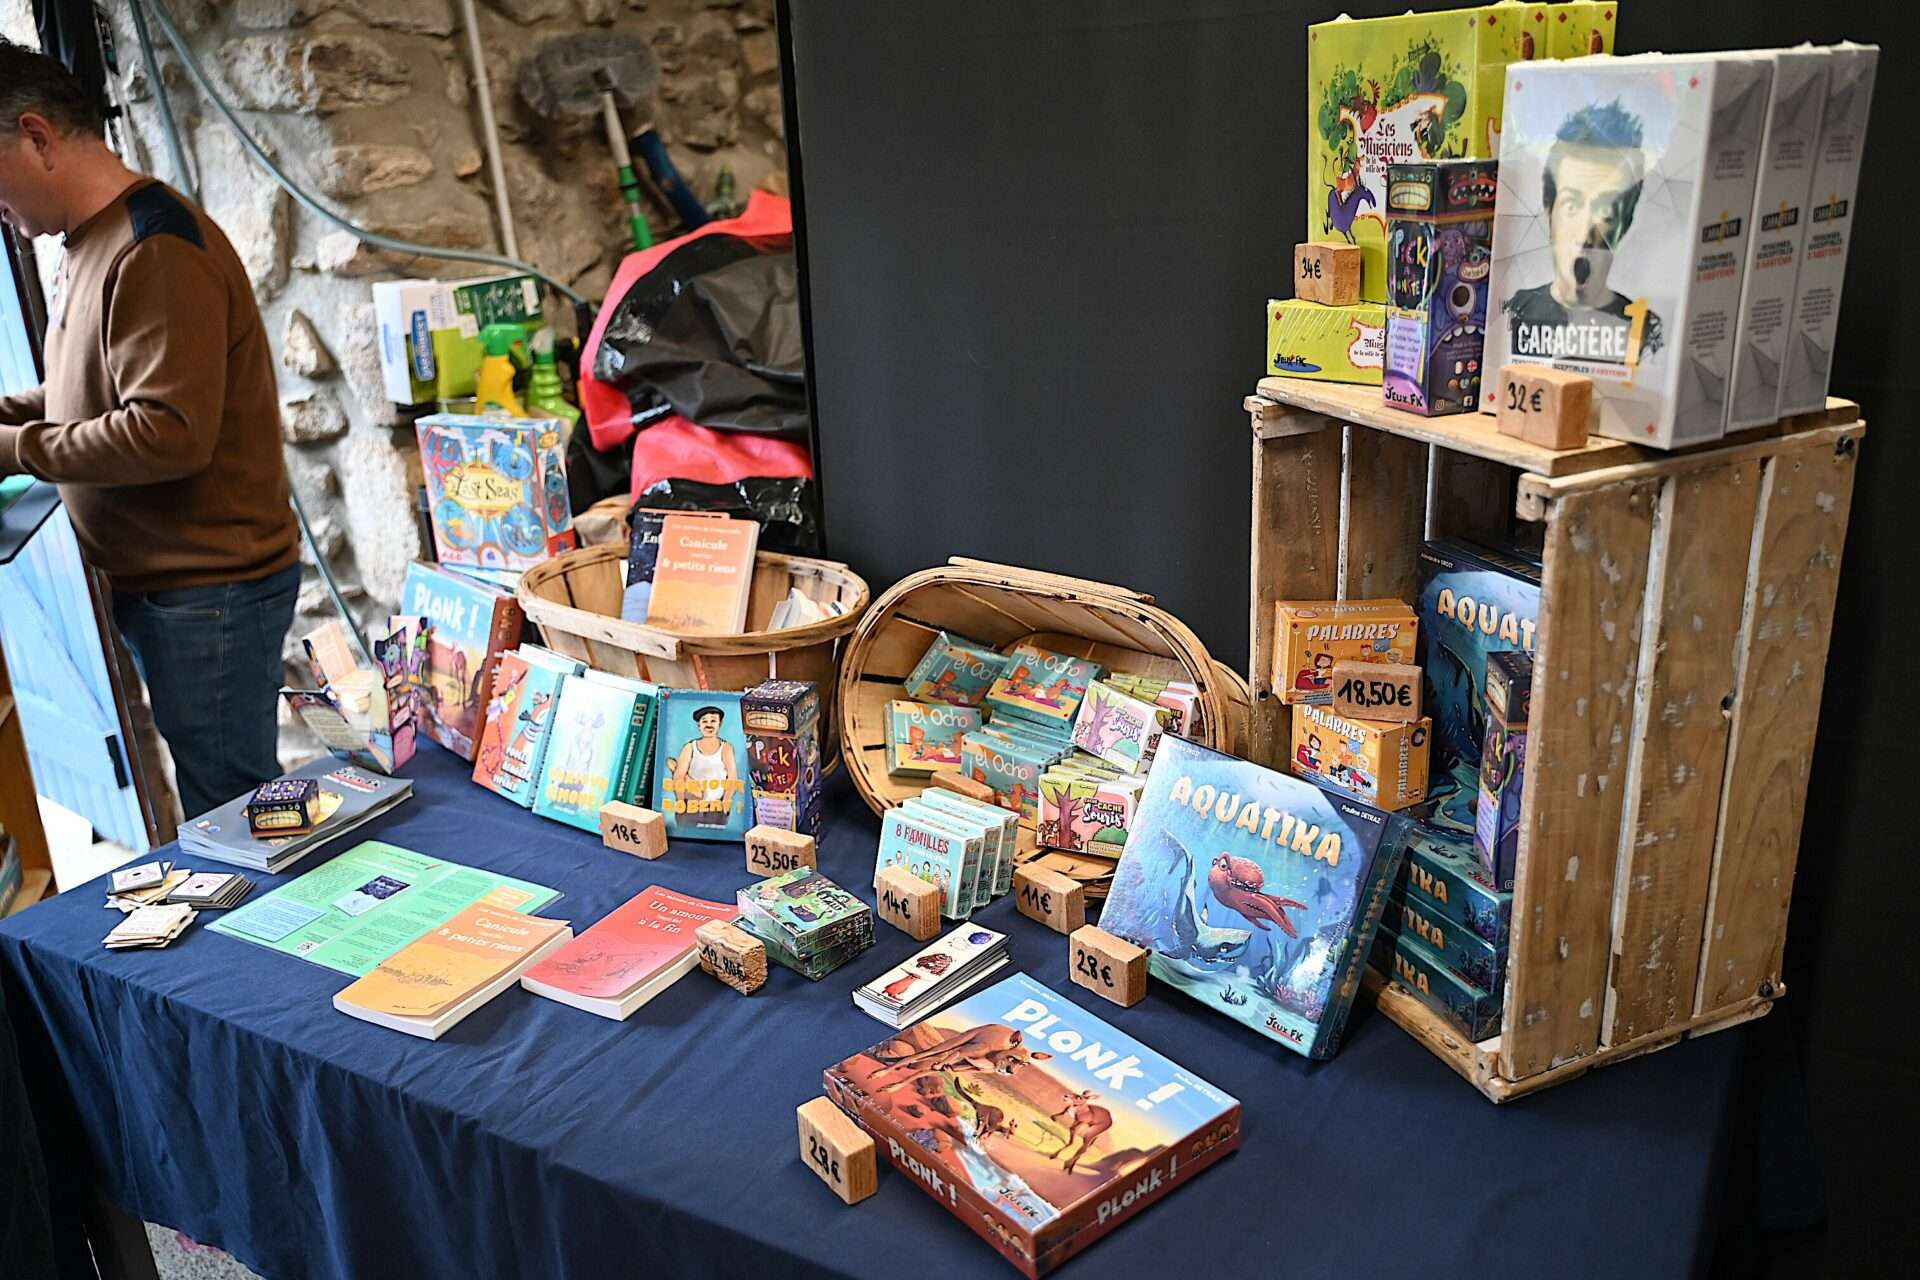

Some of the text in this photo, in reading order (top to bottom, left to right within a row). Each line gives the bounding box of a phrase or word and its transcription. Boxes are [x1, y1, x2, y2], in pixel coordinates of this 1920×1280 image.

[1376, 118, 1395, 136] Les
[1359, 136, 1413, 156] Musiciens
[1302, 257, 1321, 279] 34€
[1517, 318, 1627, 357] CARACTÈRE
[1508, 381, 1544, 413] 32€
[680, 536, 728, 550] Canicule
[414, 582, 465, 633] PLONK
[1437, 588, 1536, 651] AQUAT
[1307, 623, 1400, 641] PALABRES
[1044, 656, 1080, 677] Ocho
[1338, 679, 1413, 708] 18,50€
[930, 707, 969, 729] Ocho
[1303, 704, 1367, 745] PALABRES
[993, 754, 1029, 781] Ocho
[1082, 803, 1126, 829] Souris
[1167, 776, 1342, 868] AQUATIKA
[611, 823, 641, 844] 18€
[896, 823, 950, 855] 8 FAMILLES
[751, 844, 799, 870] 23,50€
[649, 900, 668, 913] Un
[670, 908, 712, 921] amour
[883, 889, 912, 920] 14€
[1022, 884, 1052, 915] 11€
[449, 932, 489, 947] petits
[474, 918, 530, 936] Canicule
[663, 923, 681, 934] fin
[1077, 949, 1114, 987] 28€
[1001, 999, 1144, 1090] PLONK
[810, 1136, 842, 1183] 28€
[888, 1136, 947, 1197] PLONK
[1097, 1168, 1163, 1224] PLONK
